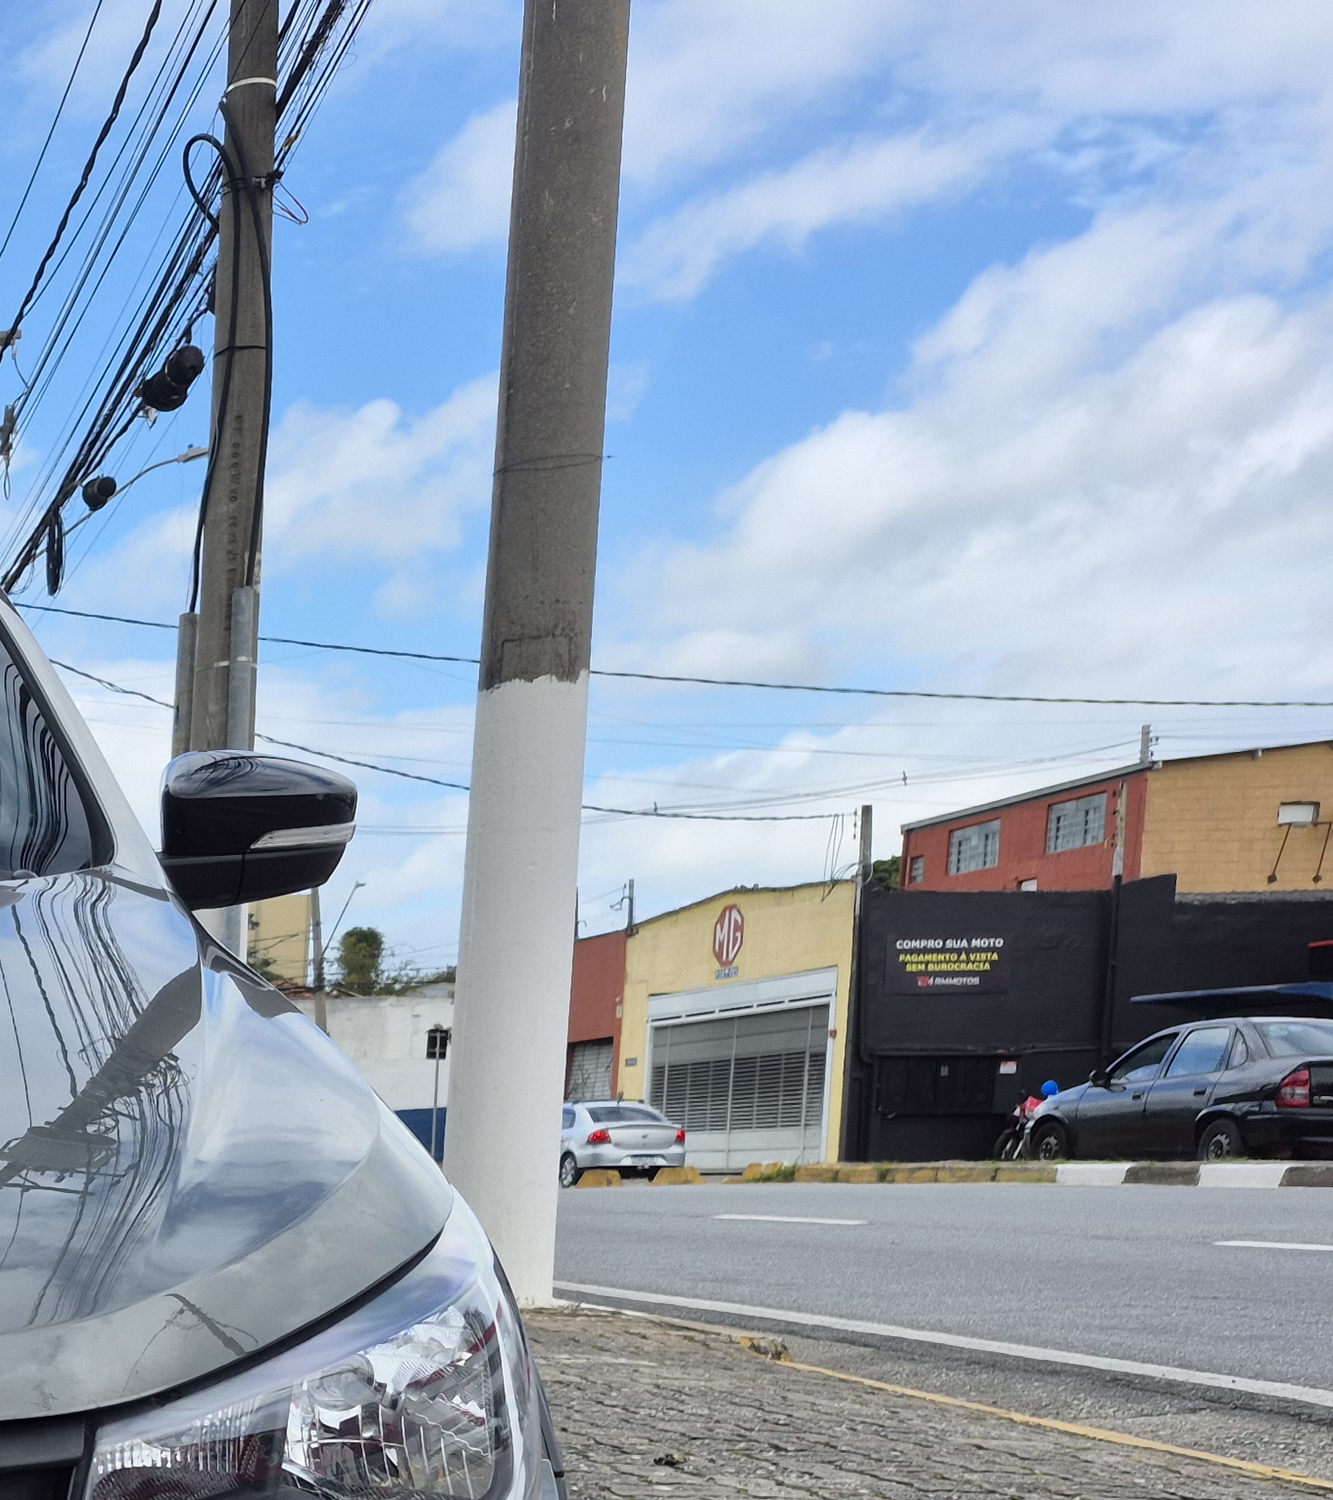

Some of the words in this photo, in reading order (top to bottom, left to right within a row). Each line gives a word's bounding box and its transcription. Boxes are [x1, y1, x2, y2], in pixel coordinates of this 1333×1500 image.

[715, 908, 742, 961] MG
[896, 939, 943, 950] COMPRO
[945, 938, 968, 949] SUA
[971, 937, 1004, 948] MOTO
[899, 953, 958, 962] PAGAMENTO
[970, 952, 999, 961] VISTA
[906, 963, 925, 972] SEM
[928, 961, 991, 971] BUROCRACIA
